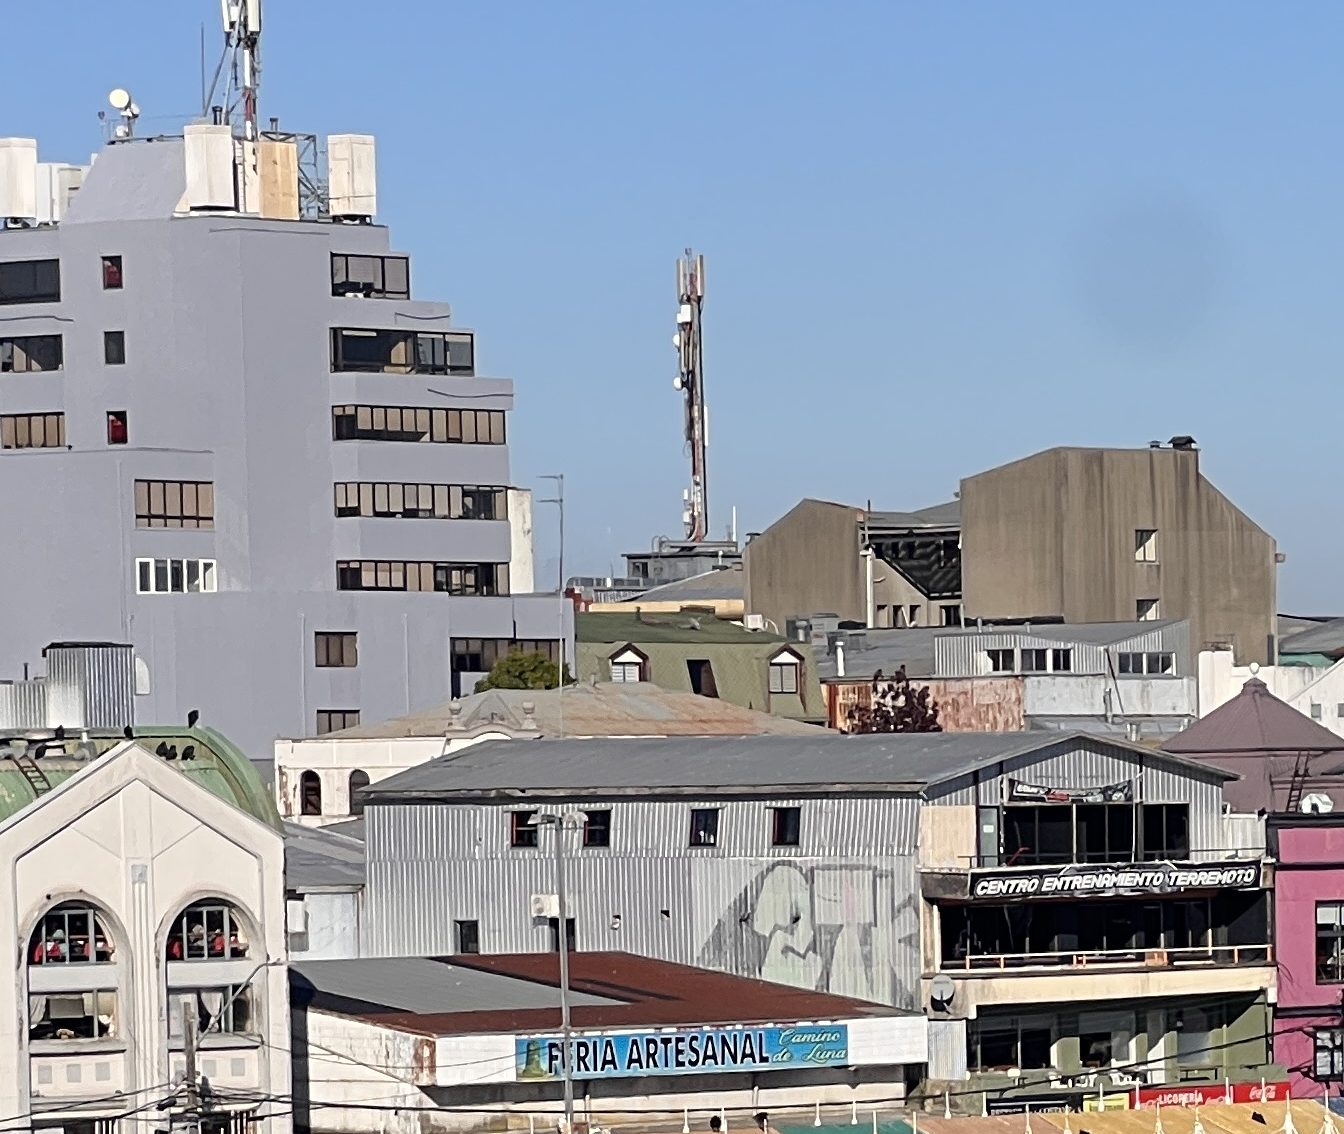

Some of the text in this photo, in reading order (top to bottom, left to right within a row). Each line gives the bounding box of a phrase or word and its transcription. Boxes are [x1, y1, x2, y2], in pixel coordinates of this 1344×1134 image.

[976, 868, 1256, 897] CENTRO ENTRENAMIENTO TERREMOTO
[778, 1028, 841, 1044] Camino
[627, 1031, 770, 1071] ARTESANAL
[772, 1042, 848, 1063] de Luna
